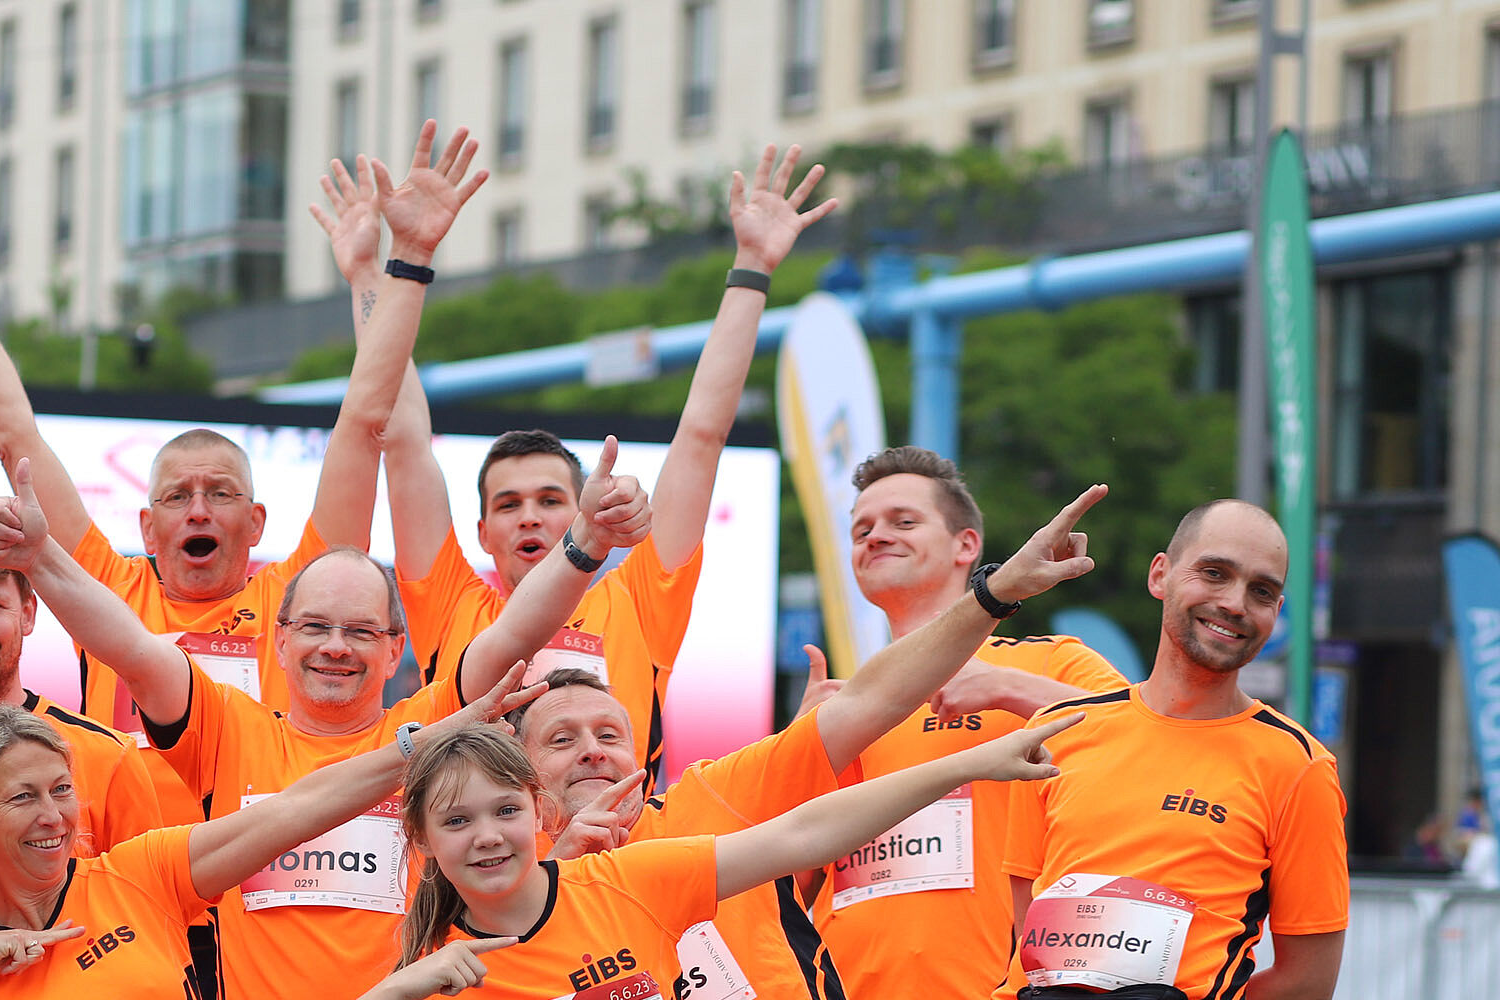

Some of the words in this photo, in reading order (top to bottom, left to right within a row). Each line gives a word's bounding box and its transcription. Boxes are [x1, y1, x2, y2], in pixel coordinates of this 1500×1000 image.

[210, 641, 247, 654] 6.6.23
[563, 635, 596, 652] 6.6.23
[369, 801, 400, 814] .6.23
[262, 850, 377, 874] omas
[294, 879, 319, 888] 0291
[1144, 888, 1186, 907] 6.6.23
[1076, 904, 1097, 914] EIBS
[1100, 905, 1105, 913] 1
[1023, 927, 1152, 954] Alexander
[1063, 959, 1088, 968] 0296
